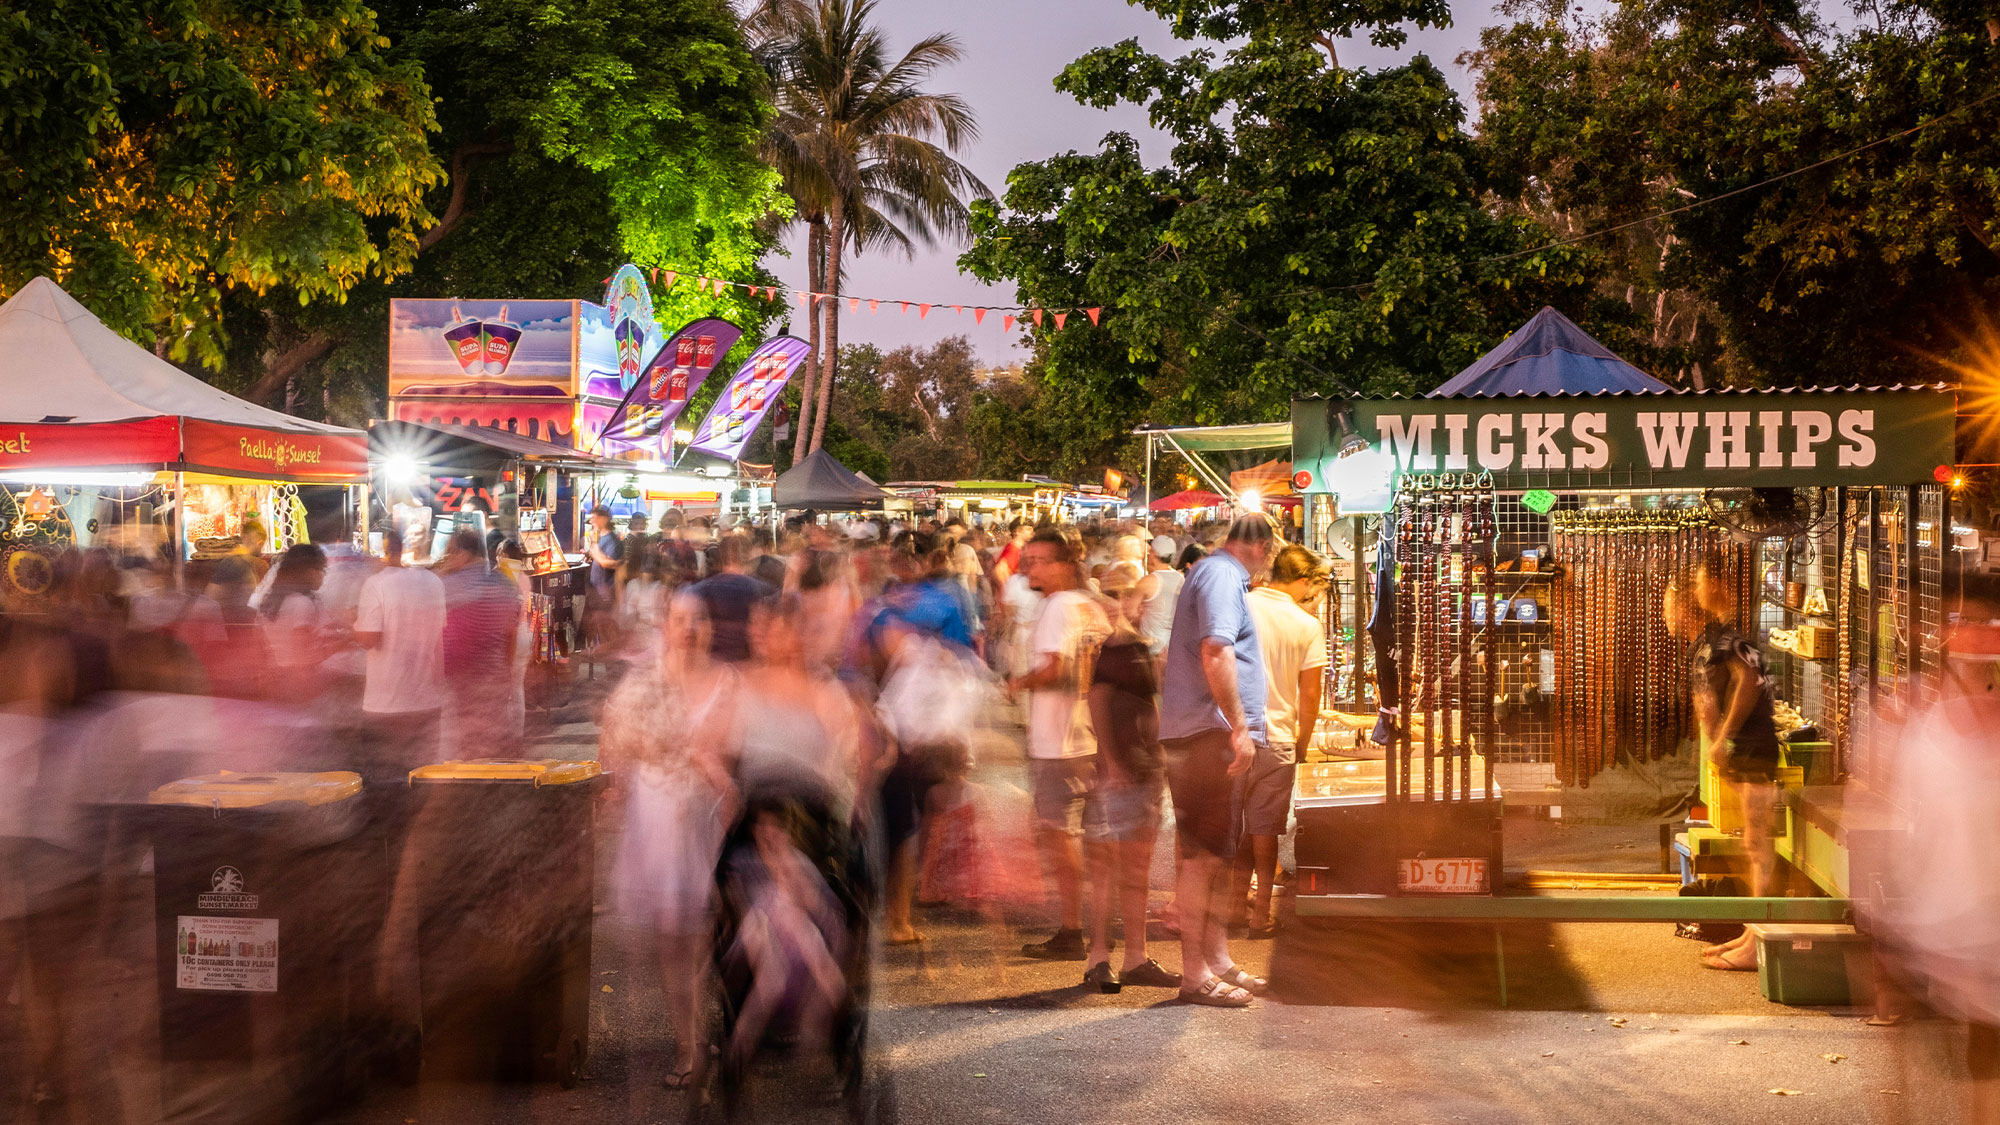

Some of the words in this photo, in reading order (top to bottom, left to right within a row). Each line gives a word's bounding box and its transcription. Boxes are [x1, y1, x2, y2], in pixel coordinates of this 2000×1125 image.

[460, 342, 478, 352] SUPA
[489, 342, 507, 351] SUPA
[1376, 412, 1609, 469] MICKS
[1636, 409, 1877, 469] WHIPS
[240, 437, 275, 460] Paella
[289, 445, 321, 463] Sunset
[1410, 862, 1486, 884] D-6775
[197, 958, 234, 967] CONTAINERS
[236, 959, 251, 967] ONLY
[252, 960, 275, 968] PLEASE
